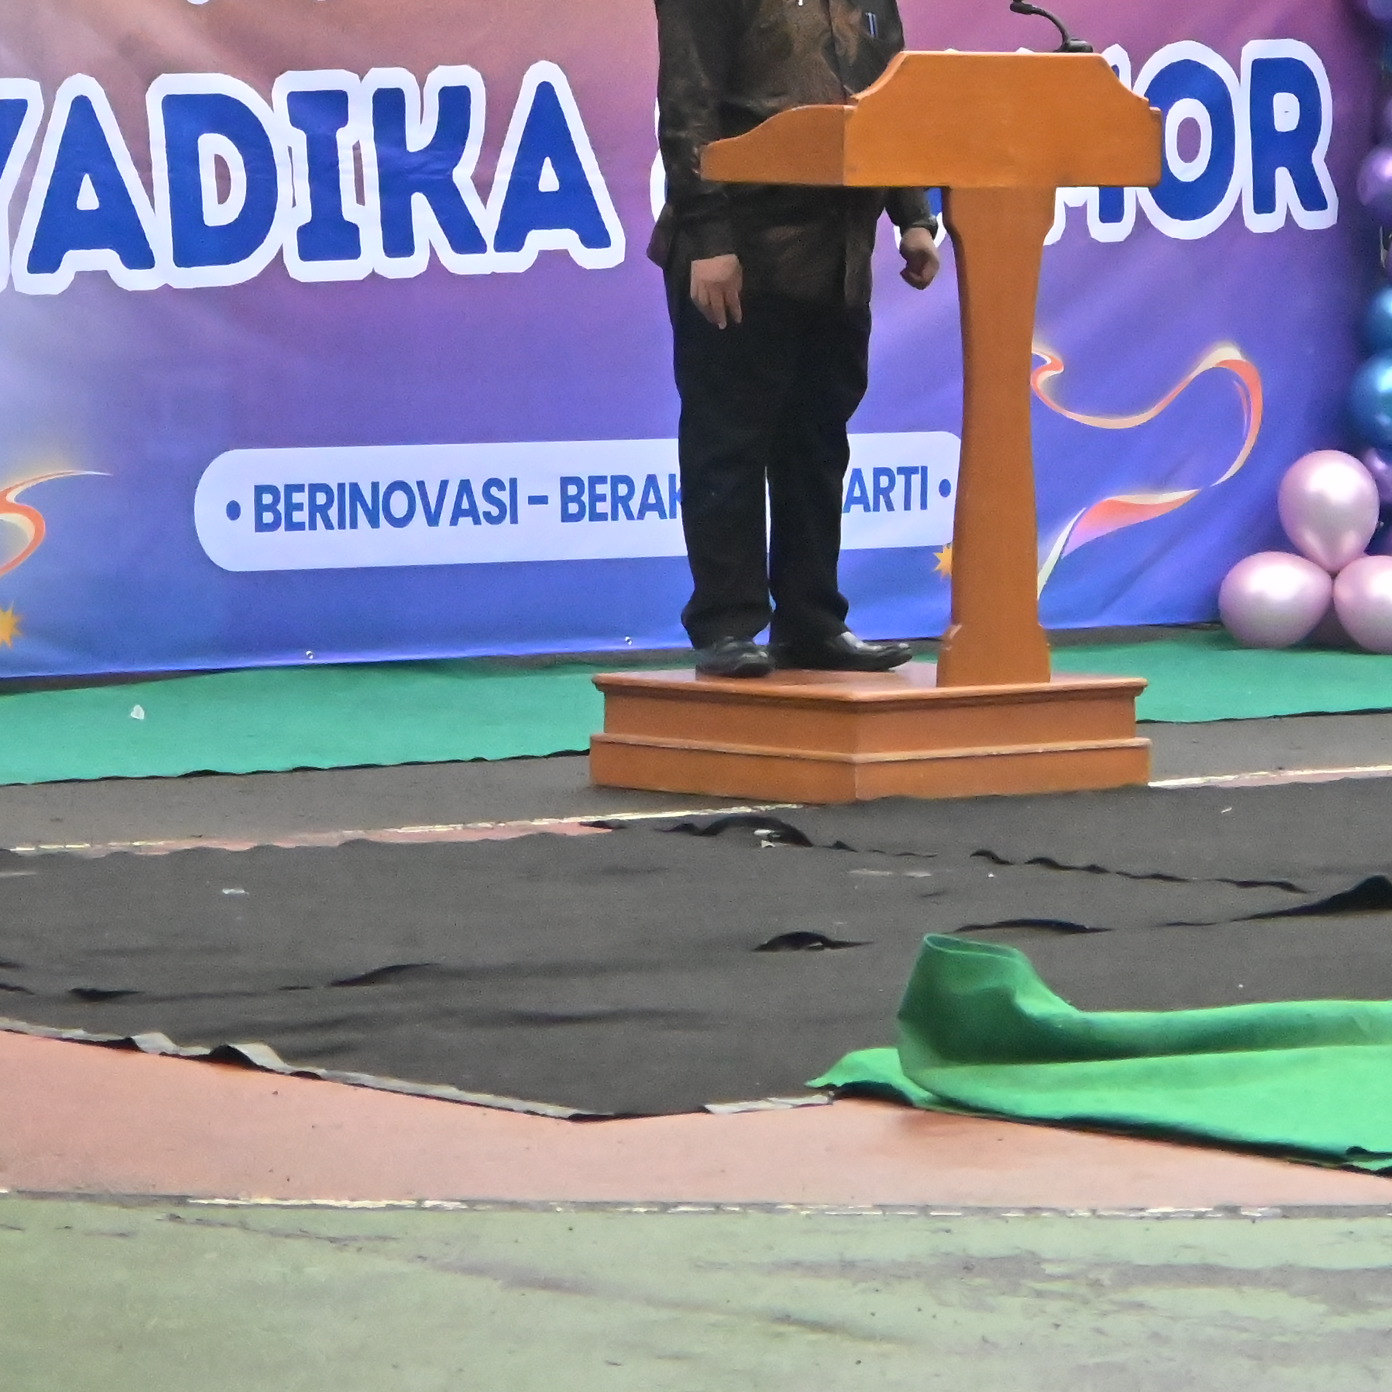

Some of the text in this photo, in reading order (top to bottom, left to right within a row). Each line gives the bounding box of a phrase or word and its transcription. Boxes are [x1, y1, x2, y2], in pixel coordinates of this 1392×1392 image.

[253, 477, 519, 533] BERINOVASI
[559, 473, 682, 523] BERAK
[843, 465, 928, 514] ARTI
